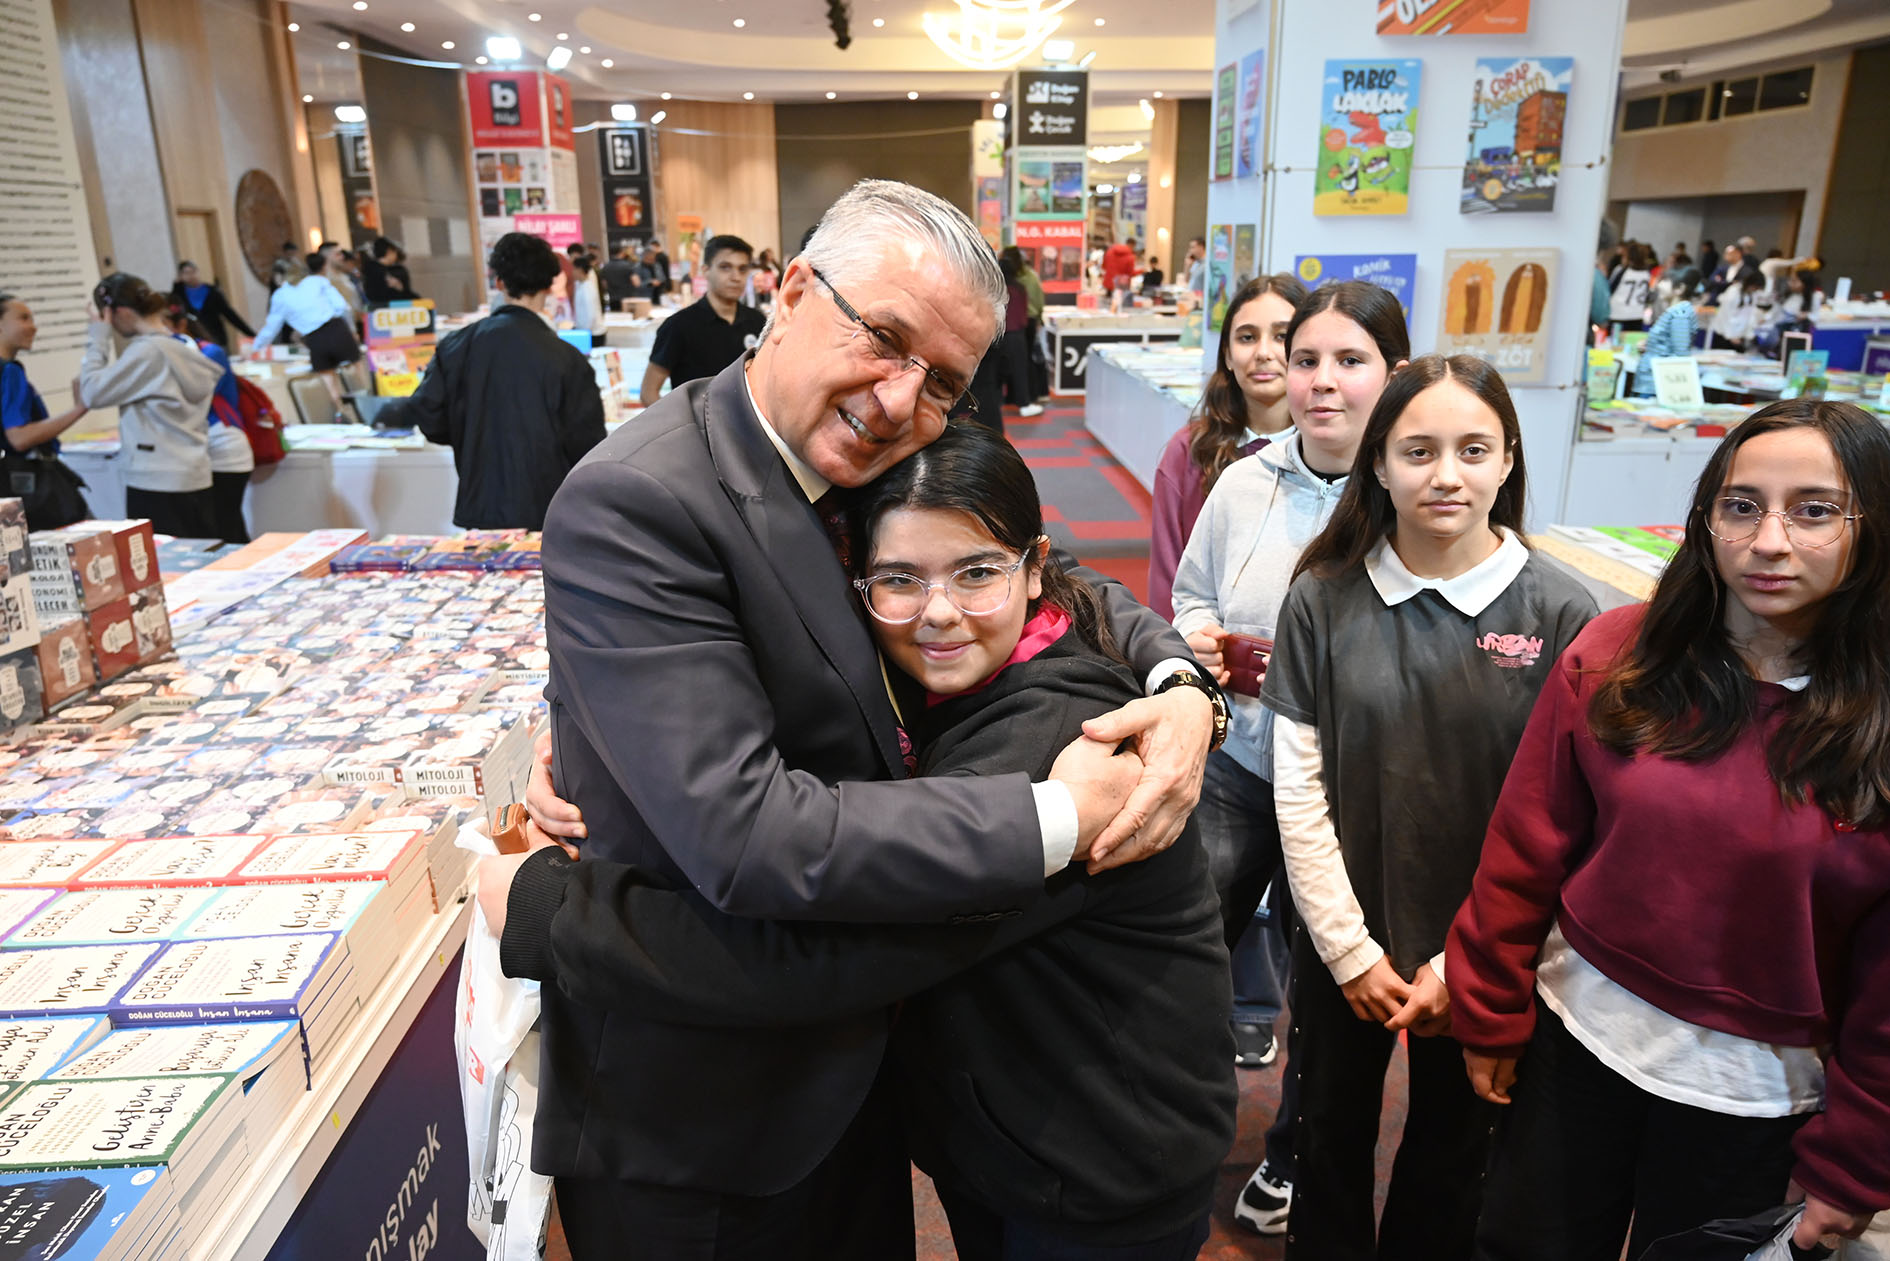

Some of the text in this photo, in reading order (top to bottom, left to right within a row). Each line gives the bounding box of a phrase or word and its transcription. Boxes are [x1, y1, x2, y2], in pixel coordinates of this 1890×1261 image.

[1343, 69, 1396, 91] PABLO
[337, 770, 385, 782] MİTOLOJİ
[416, 768, 464, 780] MİTOLOJİ
[419, 783, 466, 796] MİTOLOJİ
[132, 965, 174, 1000] DOĞAN
[219, 958, 268, 996] İnsan
[128, 1006, 274, 1020] DOĞAN CÜCELOĞLU İnsan İnsana
[92, 1085, 157, 1151] Geliştiren
[128, 1083, 186, 1150] Anne-Baba
[5, 1201, 56, 1244] İNSAN
